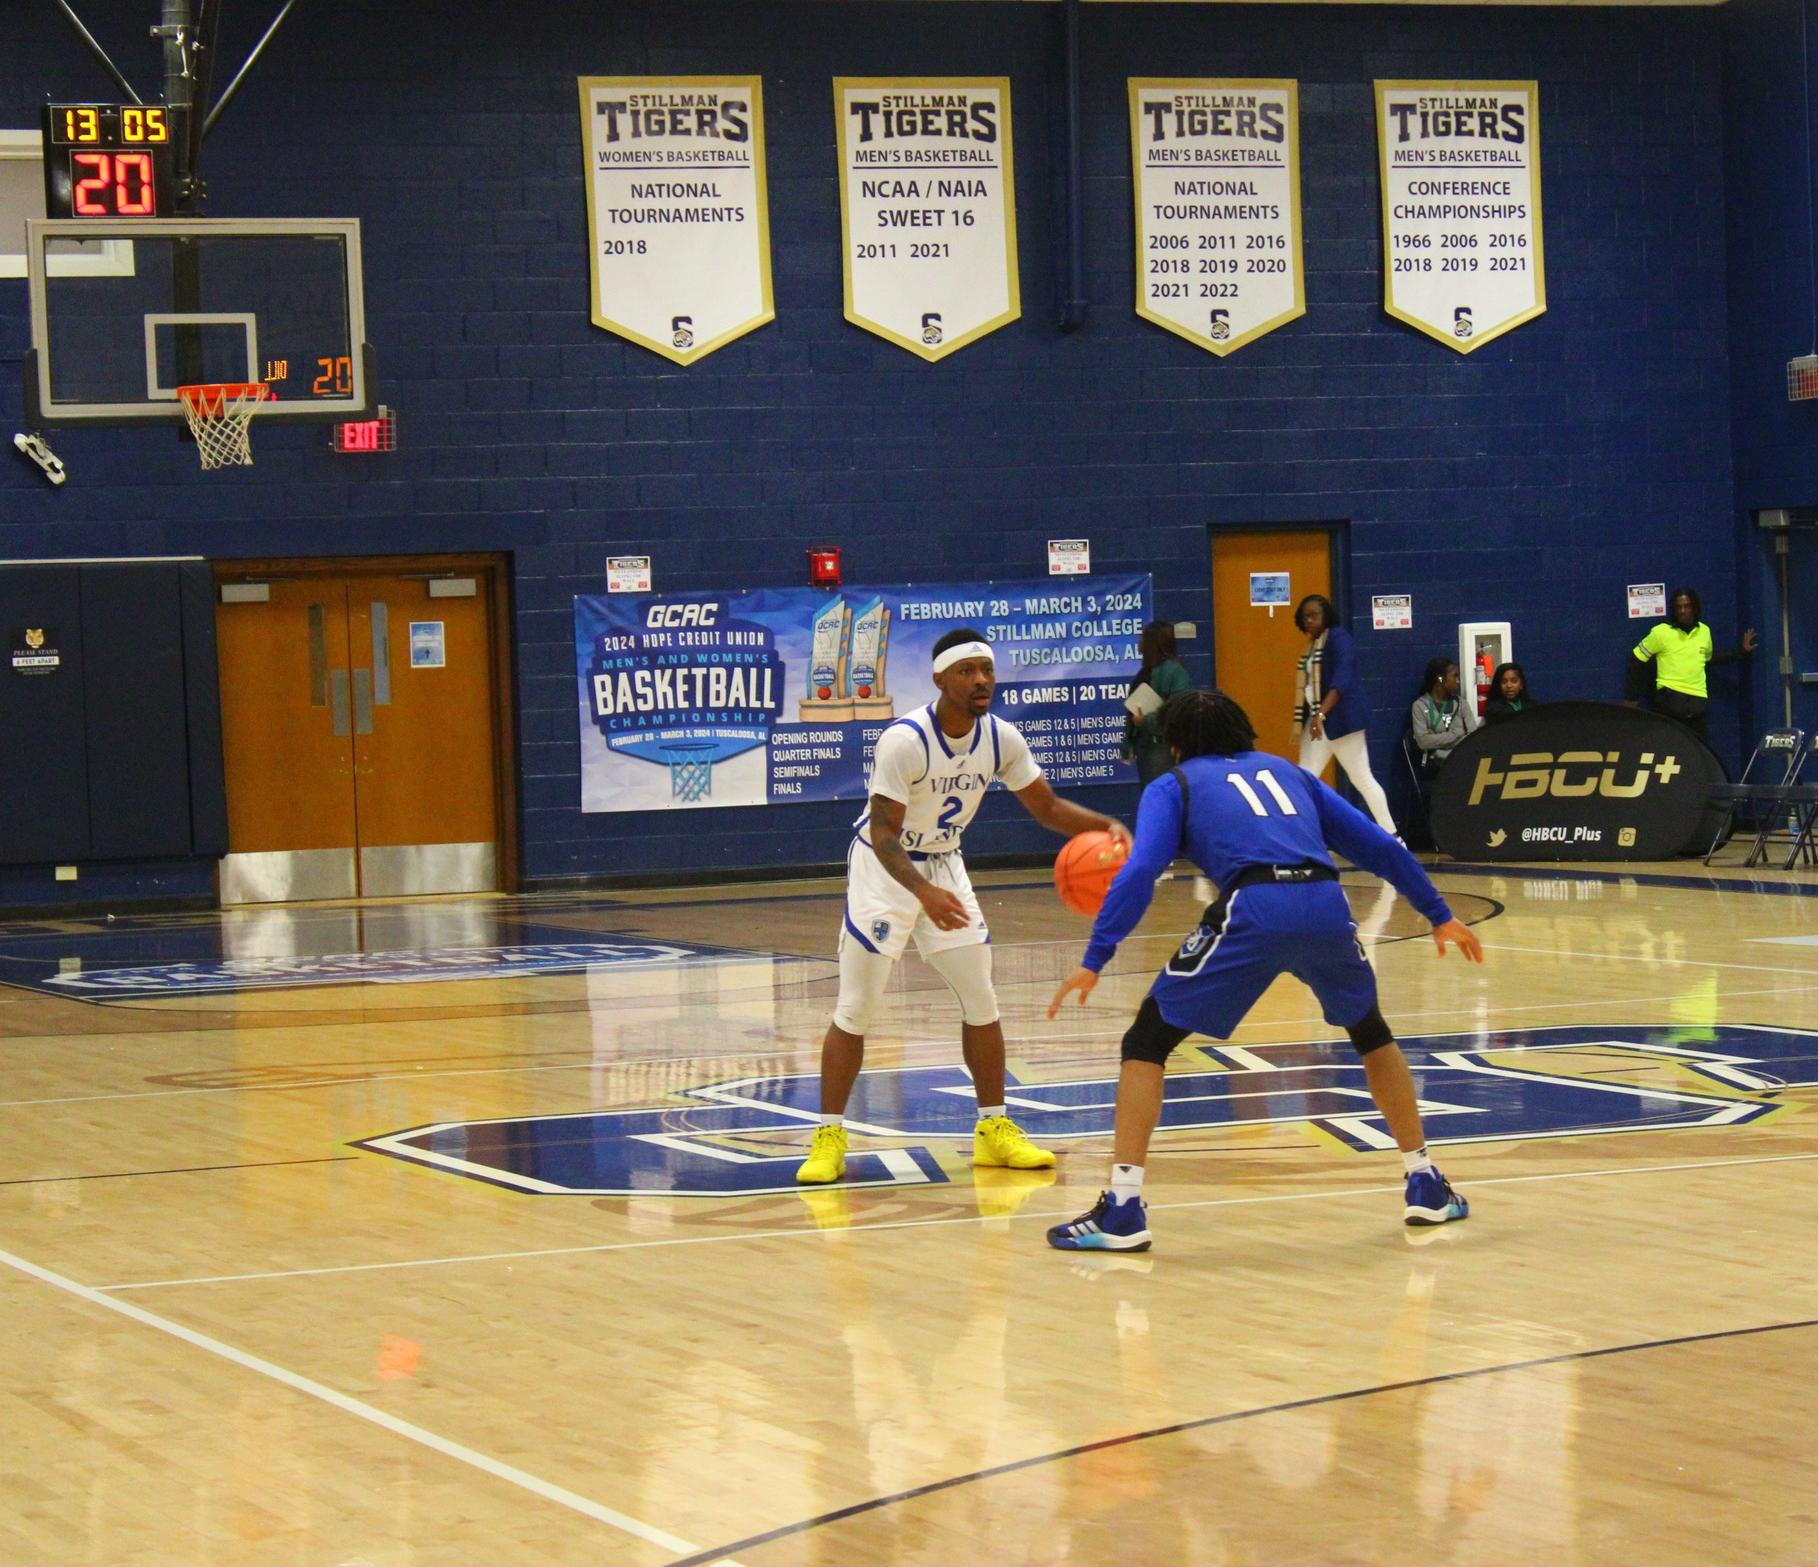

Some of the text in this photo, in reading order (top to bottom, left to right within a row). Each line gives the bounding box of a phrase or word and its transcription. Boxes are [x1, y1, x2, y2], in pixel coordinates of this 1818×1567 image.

[629, 95, 719, 107] STILLMAN
[882, 96, 967, 108] STILLMAN
[1174, 96, 1256, 108] STILLMAN
[1419, 98, 1498, 109] STILLMAN
[597, 100, 749, 143] TIGERS
[850, 101, 997, 143] TIGERS
[1144, 101, 1284, 143] TIGERS
[1390, 103, 1525, 144] TIGERS
[598, 150, 750, 162] WOMEN'S BASKETBALL
[855, 150, 994, 162] MEN'S BASKETBALL
[1148, 149, 1282, 162] MEN'S BASKETBALL
[1394, 150, 1522, 162] MEN'S BASKETBALL
[74, 153, 153, 214] 20
[631, 183, 721, 198] NATIONAL
[862, 180, 920, 198] NCAA
[938, 180, 988, 198] NAIA
[1174, 181, 1258, 196] NATIONAL
[1408, 181, 1511, 196] CONFERENCE
[608, 207, 745, 224] TOURNAMENTS
[877, 209, 975, 227] SWEET 16
[1153, 205, 1280, 220] TOURNAMENTS
[1393, 204, 1527, 220] CHAMPIONSHIPS
[604, 240, 647, 255] 2018
[1150, 235, 1286, 249] 2006 2011 2016
[1393, 234, 1527, 248] 1966 2006 2016
[857, 243, 950, 258] 2011 2021
[1150, 259, 1287, 273] 2018 2019 2020
[1394, 257, 1526, 272] 2018 2019 2021
[1151, 283, 1239, 298] 2021 2022
[343, 421, 380, 449] EXIT
[900, 601, 985, 620] FEBRUARY
[990, 600, 1009, 617] 28
[1025, 597, 1082, 615] MARCH
[1087, 596, 1101, 614] 3,
[1105, 593, 1142, 611] 2024
[646, 603, 719, 628] GCAC
[986, 619, 1143, 641] STILLMAN COLLEGE
[604, 632, 764, 651] 2024 HOPE CREDIT UNION
[603, 653, 768, 669] MEN'S AND WOMEN'S
[1009, 644, 1143, 666] TUSCALOOSA, AL
[593, 667, 776, 715] BASKETBALL
[1002, 690, 1018, 705] 18
[1021, 687, 1069, 704] GAMES
[1080, 685, 1096, 701] 20
[610, 712, 766, 729] CHAMPIONSHIP
[1025, 720, 1051, 732] GAMES
[1054, 719, 1061, 730] 12
[772, 730, 844, 745] OPENING ROUNDS
[773, 747, 841, 762] QUARTER FINALS
[1055, 752, 1063, 763] 12
[773, 765, 820, 778] SEMIFINALS
[1085, 766, 1107, 777] GAME
[1108, 765, 1114, 776] 5
[773, 782, 802, 795] FINALS
[1226, 769, 1298, 817] 11
[937, 796, 963, 829] 2
[1521, 826, 1602, 843] @HBCU_Plus
